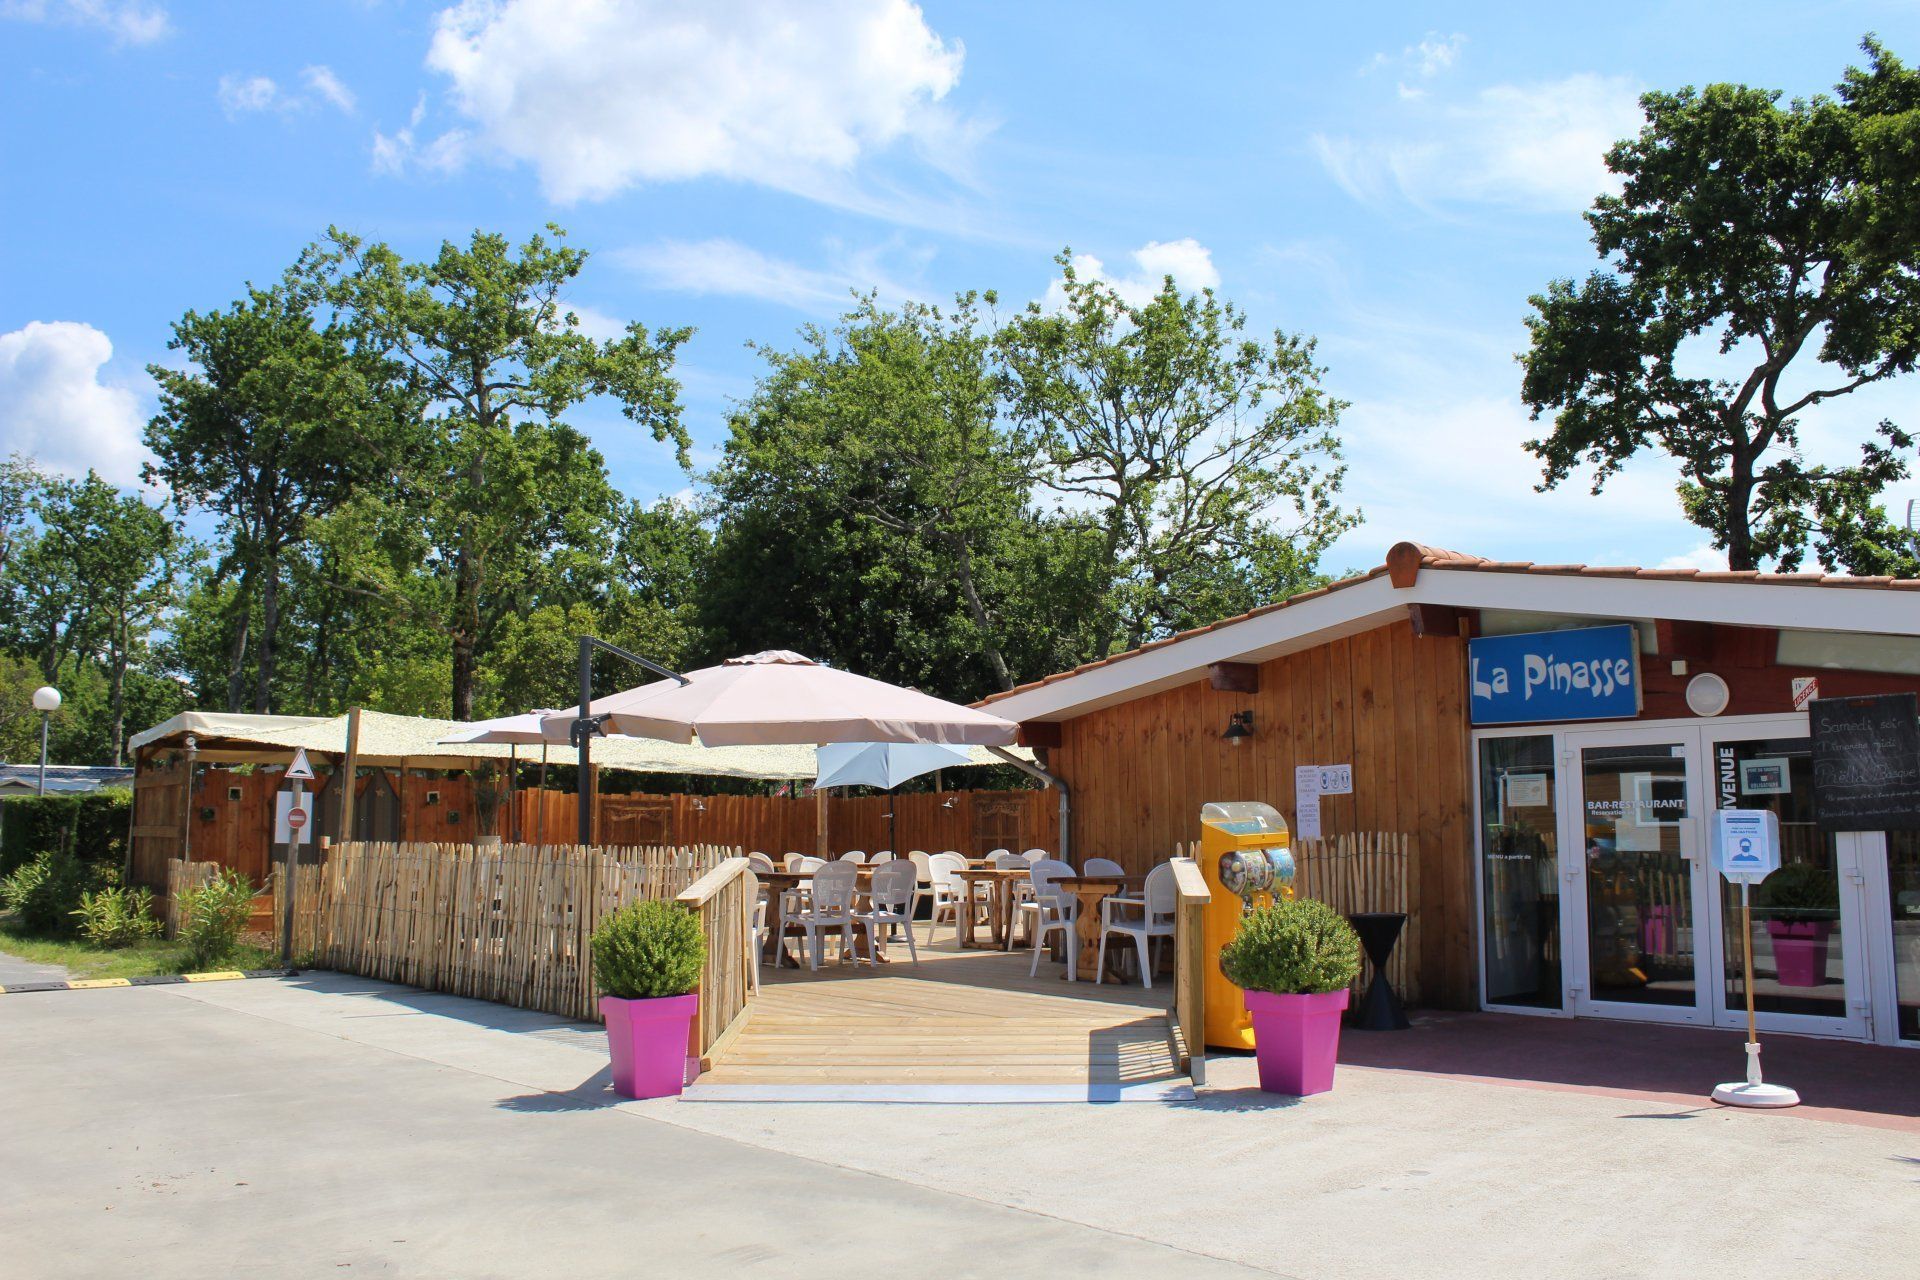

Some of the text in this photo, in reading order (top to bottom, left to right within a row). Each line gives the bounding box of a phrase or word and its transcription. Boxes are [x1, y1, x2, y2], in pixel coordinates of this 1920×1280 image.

[1472, 653, 1630, 701] La Pinasse
[1794, 679, 1817, 708] LICENCE
[1821, 716, 1873, 734] Samedi
[1720, 748, 1737, 809] VENUE
[1587, 799, 1685, 810] BAR-RESTAURANT
